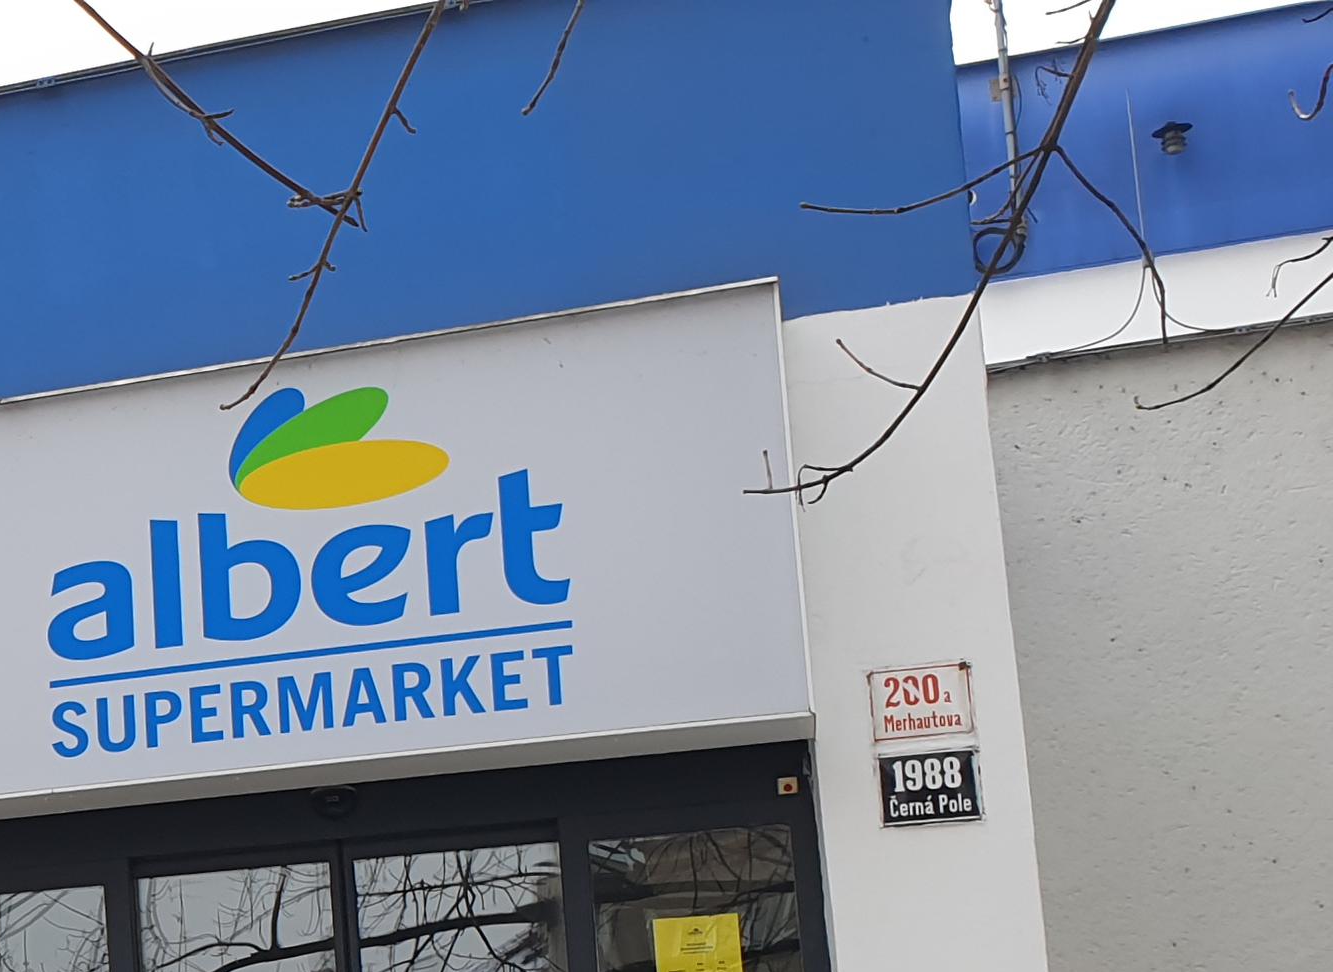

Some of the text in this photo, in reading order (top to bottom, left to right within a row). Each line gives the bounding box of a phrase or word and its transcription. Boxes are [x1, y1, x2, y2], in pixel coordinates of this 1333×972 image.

[47, 469, 571, 660] albert
[50, 644, 574, 758] SUPERMARKET
[884, 710, 963, 733] Merhautova
[892, 756, 962, 793] 1988
[889, 793, 972, 817] Černá Pole
